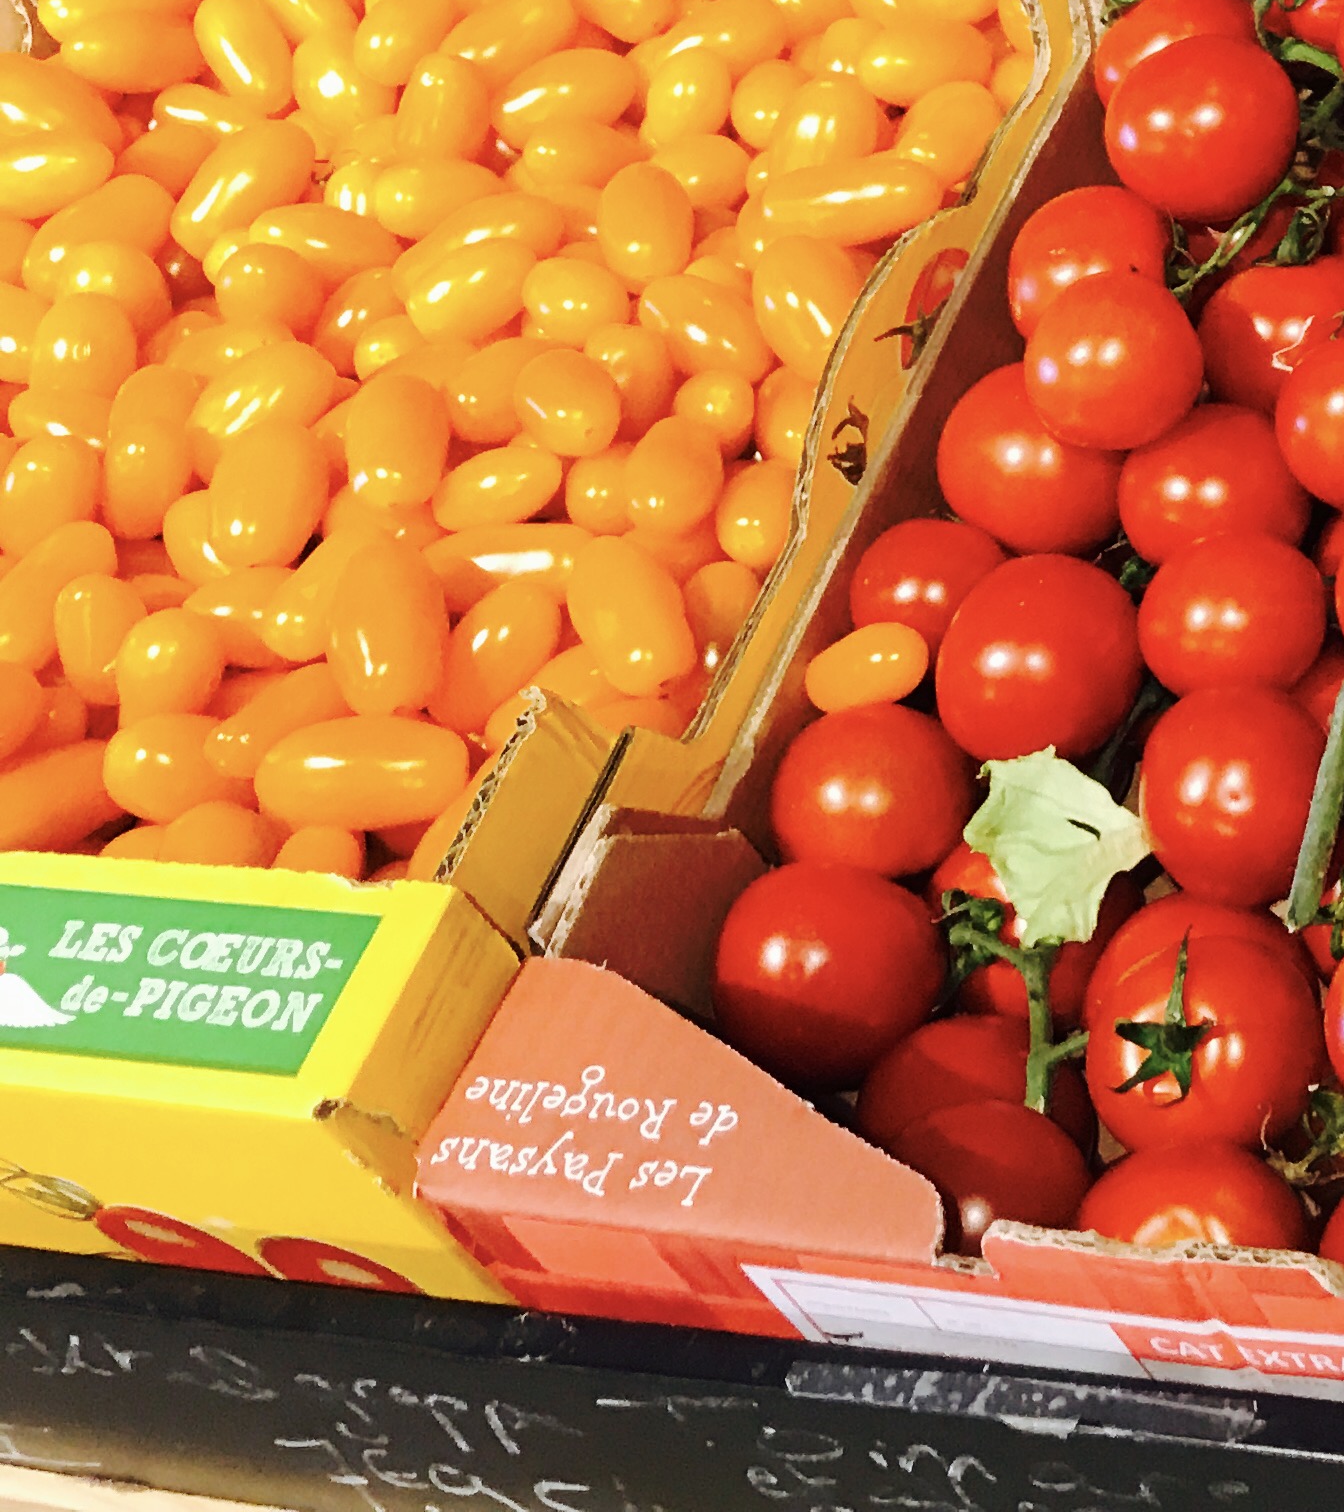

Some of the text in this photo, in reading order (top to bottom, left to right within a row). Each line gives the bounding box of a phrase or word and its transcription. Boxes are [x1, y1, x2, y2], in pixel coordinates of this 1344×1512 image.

[48, 919, 144, 963] LES
[60, 974, 324, 1033] de-PIGEON
[465, 1064, 739, 1146] de Rougeline
[430, 1130, 713, 1207] Les Paysans
